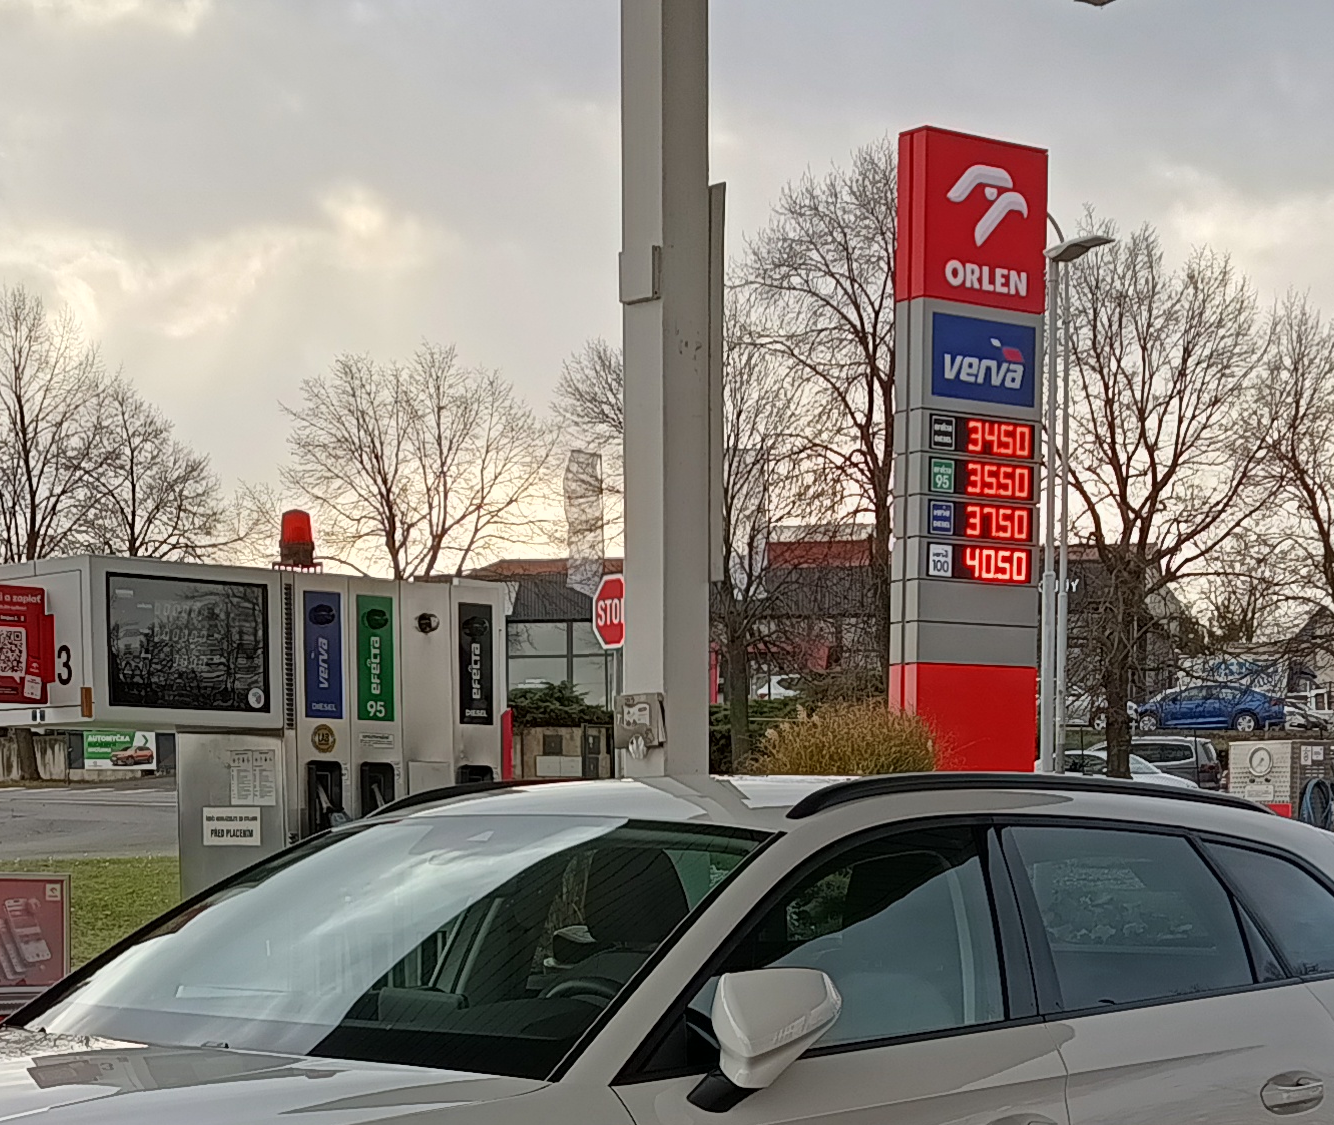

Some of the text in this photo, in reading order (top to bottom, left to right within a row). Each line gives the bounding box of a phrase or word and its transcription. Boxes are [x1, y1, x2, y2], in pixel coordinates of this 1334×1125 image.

[945, 259, 1028, 296] ORLEN
[944, 353, 1025, 390] verva
[935, 474, 950, 489] 95
[932, 559, 949, 573] 100
[12, 592, 42, 604] zaplať
[57, 644, 73, 686] 3
[318, 637, 329, 689] verva
[367, 701, 386, 718] 95
[87, 733, 131, 742] AUTOMYČKA
